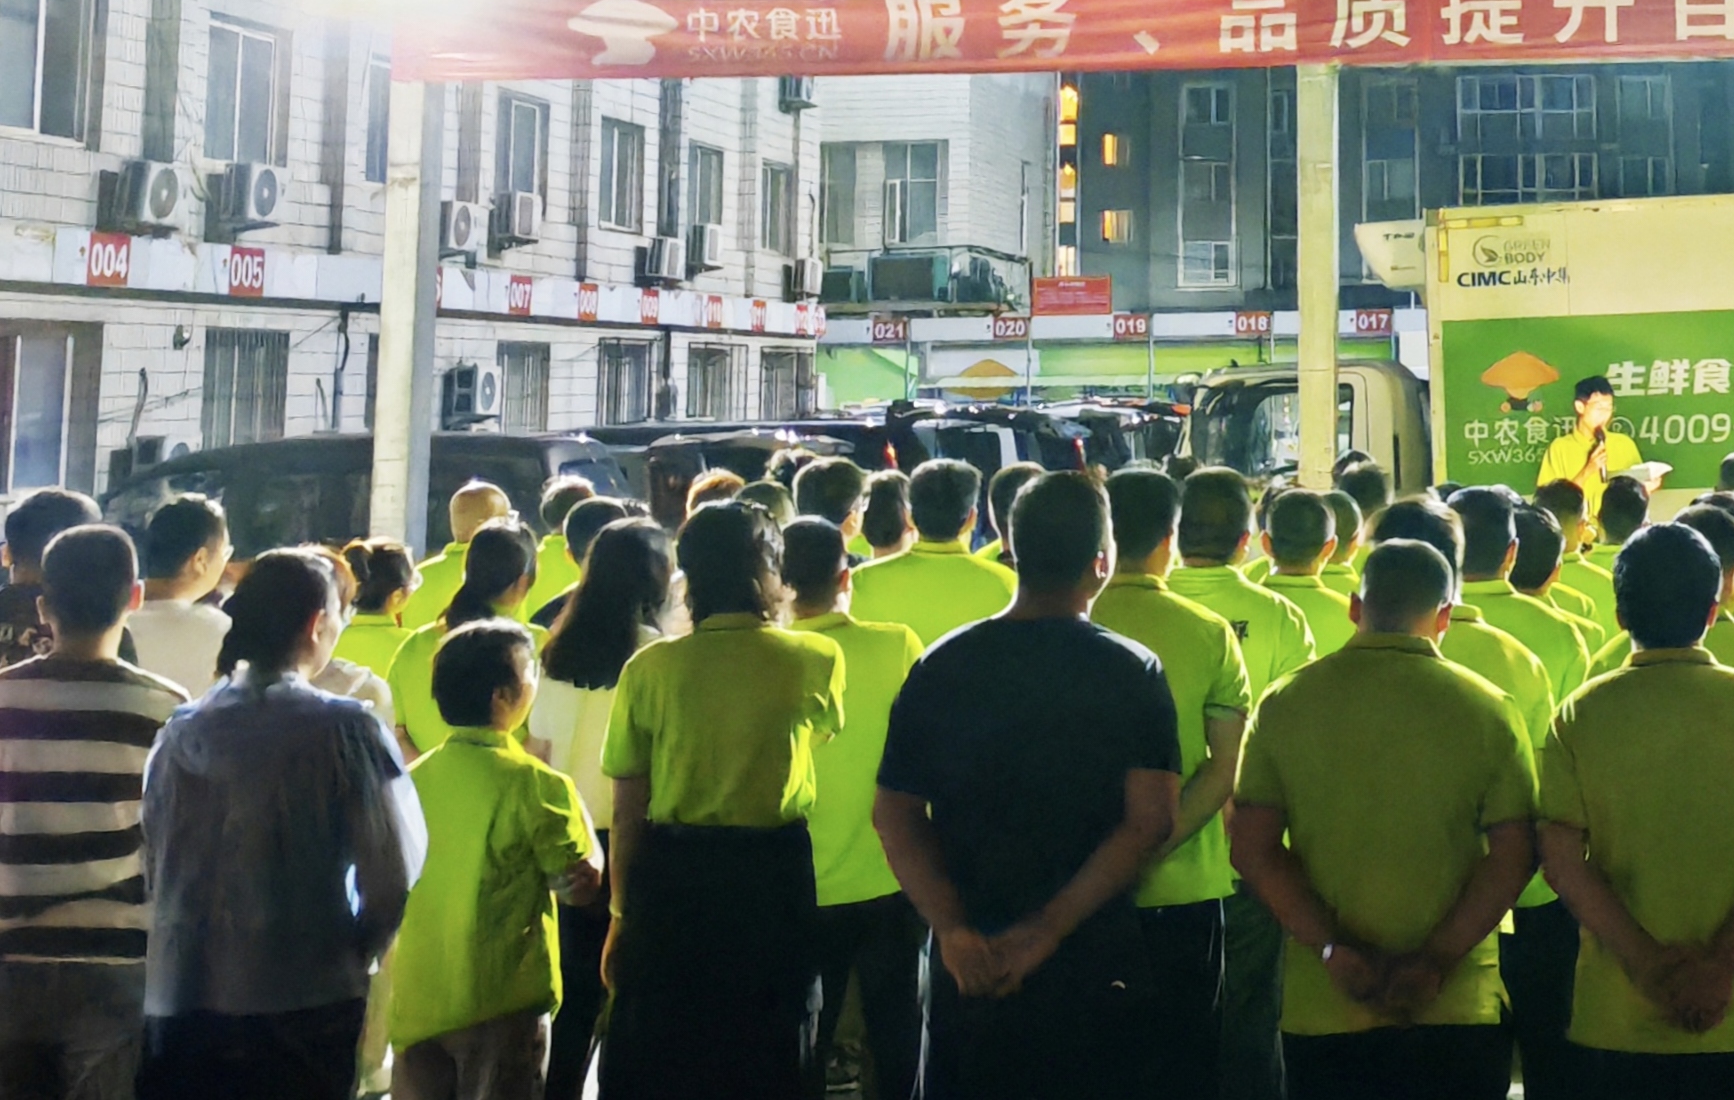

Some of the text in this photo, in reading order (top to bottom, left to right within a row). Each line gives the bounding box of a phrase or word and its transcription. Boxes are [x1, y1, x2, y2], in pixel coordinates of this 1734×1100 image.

[687, 7, 842, 42] 中农食迅
[91, 243, 128, 279] 004
[1504, 251, 1545, 265] BODY
[231, 253, 264, 289] 005
[1456, 270, 1512, 288] CIMC
[511, 282, 531, 309] 007
[995, 320, 1025, 337] 020
[1115, 318, 1146, 334] 019
[1237, 316, 1267, 333] 018
[1358, 313, 1389, 330] 017
[875, 322, 904, 339] 021
